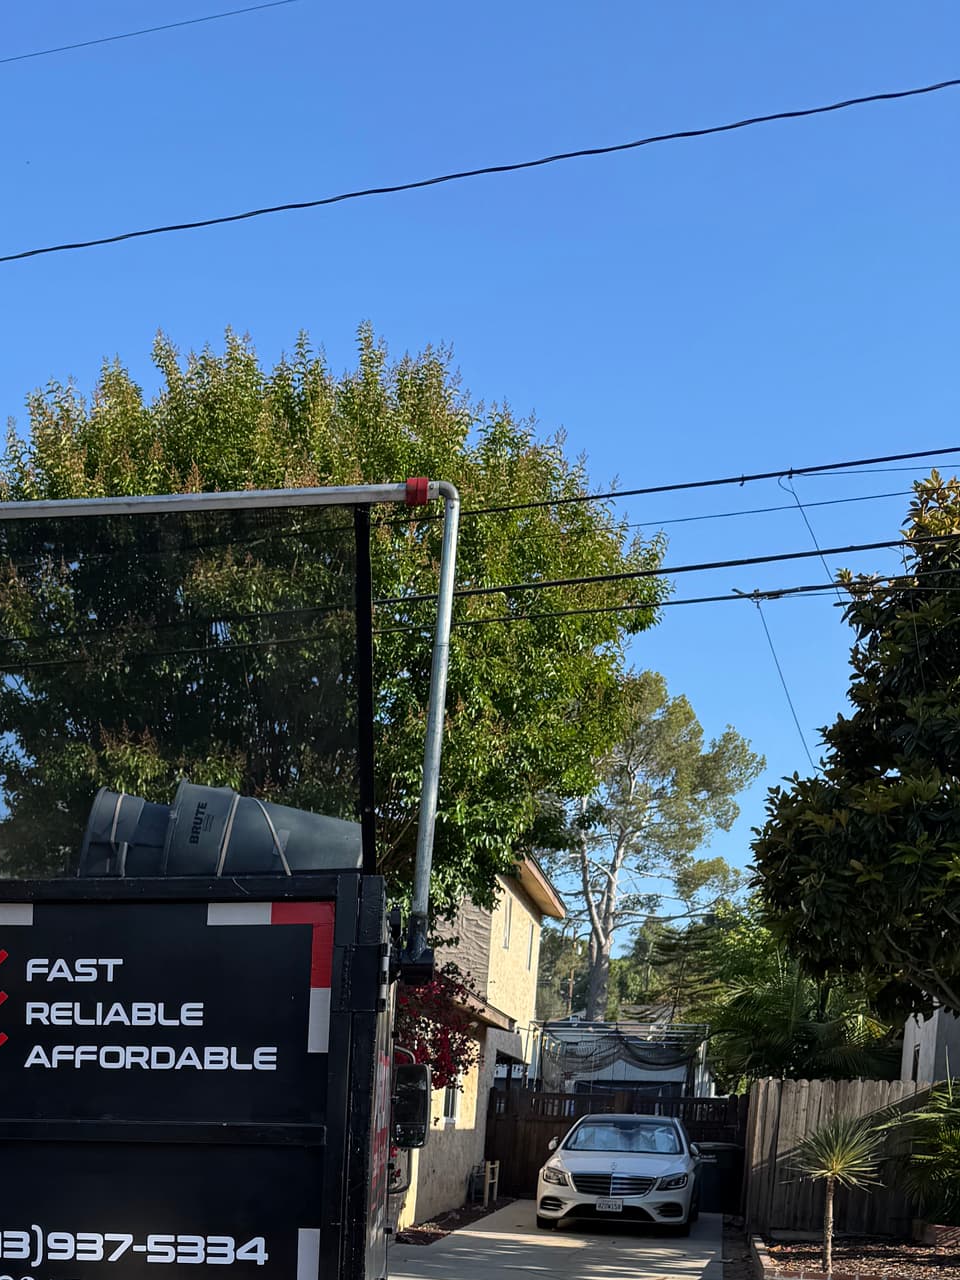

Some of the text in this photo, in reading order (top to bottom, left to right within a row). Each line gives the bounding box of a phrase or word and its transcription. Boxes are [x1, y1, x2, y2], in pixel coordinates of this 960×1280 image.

[189, 801, 208, 844] BRUTE
[26, 958, 123, 982] FAST
[25, 1002, 204, 1026] RELIABLE
[24, 1045, 277, 1070] AFFORDABLE
